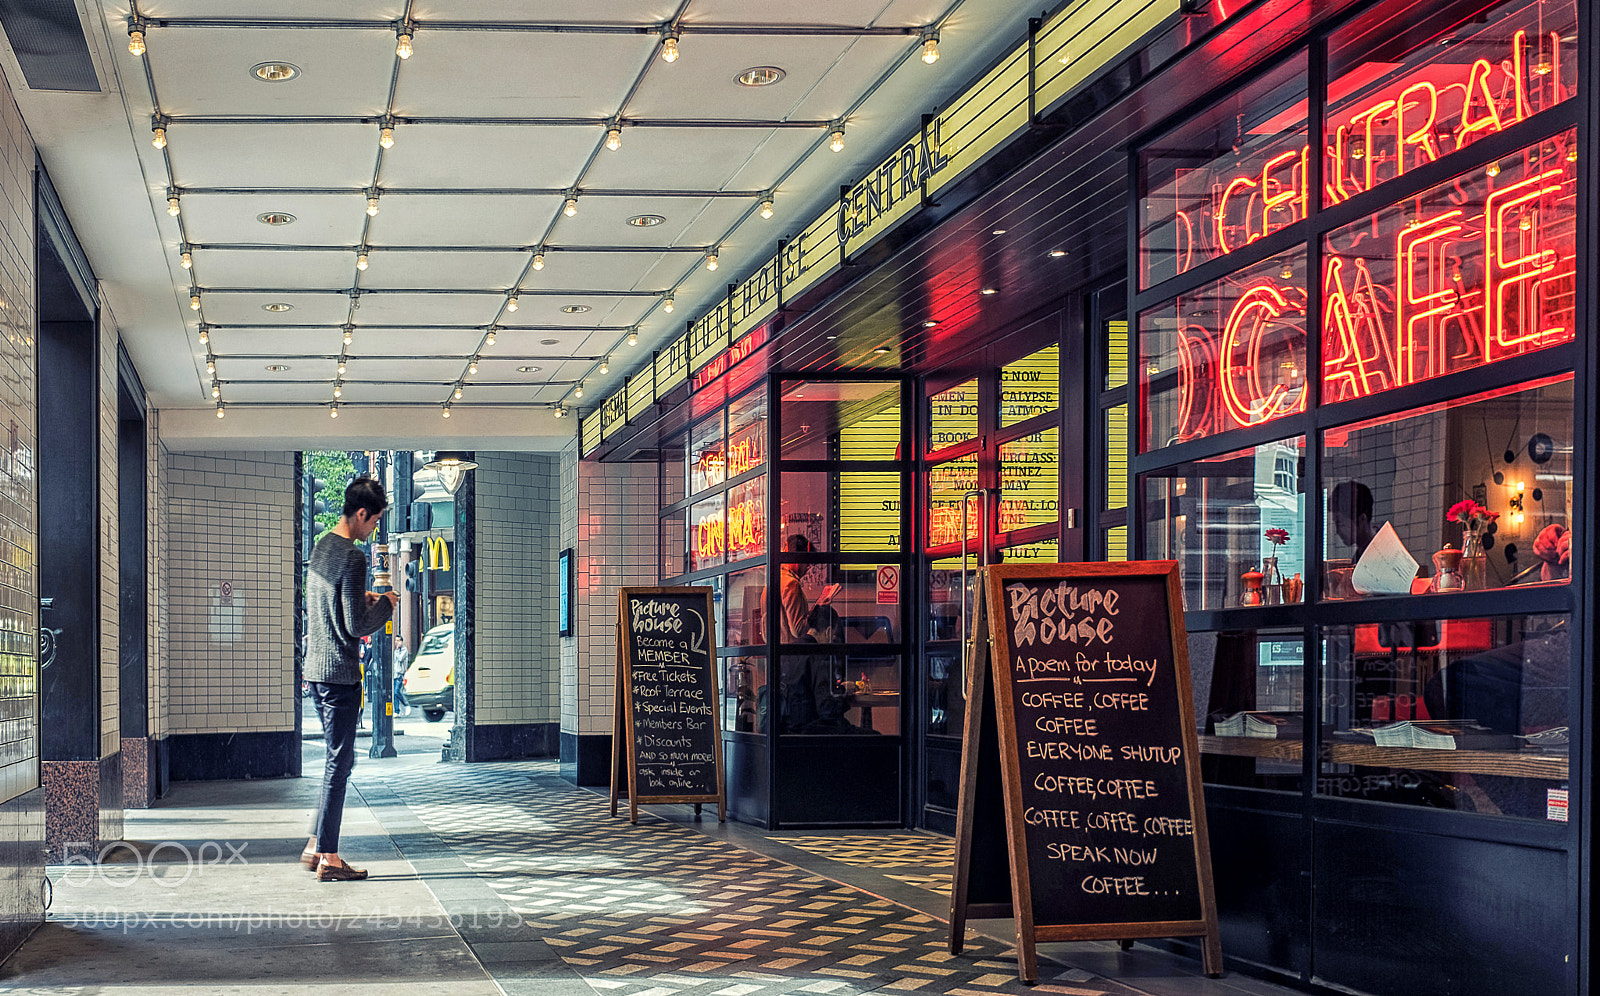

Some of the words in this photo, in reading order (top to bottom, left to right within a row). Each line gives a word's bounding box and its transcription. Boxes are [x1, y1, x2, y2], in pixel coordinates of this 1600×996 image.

[1217, 30, 1526, 255] CENTRAL
[837, 117, 948, 244] CENTRAL
[1219, 168, 1564, 428] CAFE
[1012, 371, 1041, 382] NOW
[937, 404, 953, 415] IN
[1004, 480, 1031, 490] MAY
[630, 598, 680, 618] Picture
[1006, 580, 1120, 621] Picture
[632, 612, 683, 634] house
[1013, 604, 1115, 648] house
[636, 635, 675, 649] Become
[637, 649, 691, 665] MEMBER
[638, 670, 659, 682] Free
[658, 669, 698, 684] Tickets
[1015, 655, 1027, 673] A
[1027, 656, 1071, 680] poem
[1074, 651, 1100, 673] for
[1103, 651, 1157, 687] today
[640, 685, 662, 697] Roof
[662, 684, 704, 700] Terrace
[642, 699, 677, 715] Special
[679, 701, 713, 716] Events
[642, 717, 682, 730] Members
[686, 718, 707, 731] Bar
[1035, 716, 1100, 737] COFFEE
[644, 734, 692, 748] Discounts
[639, 750, 657, 760] AND
[659, 751, 669, 760] SO
[1026, 740, 1114, 761] EVERYONE
[638, 767, 656, 776] ask
[660, 765, 684, 778] inside
[1023, 806, 1081, 829] COFFEE
[1046, 842, 1112, 863] SPEAK
[1113, 847, 1158, 866] NOW
